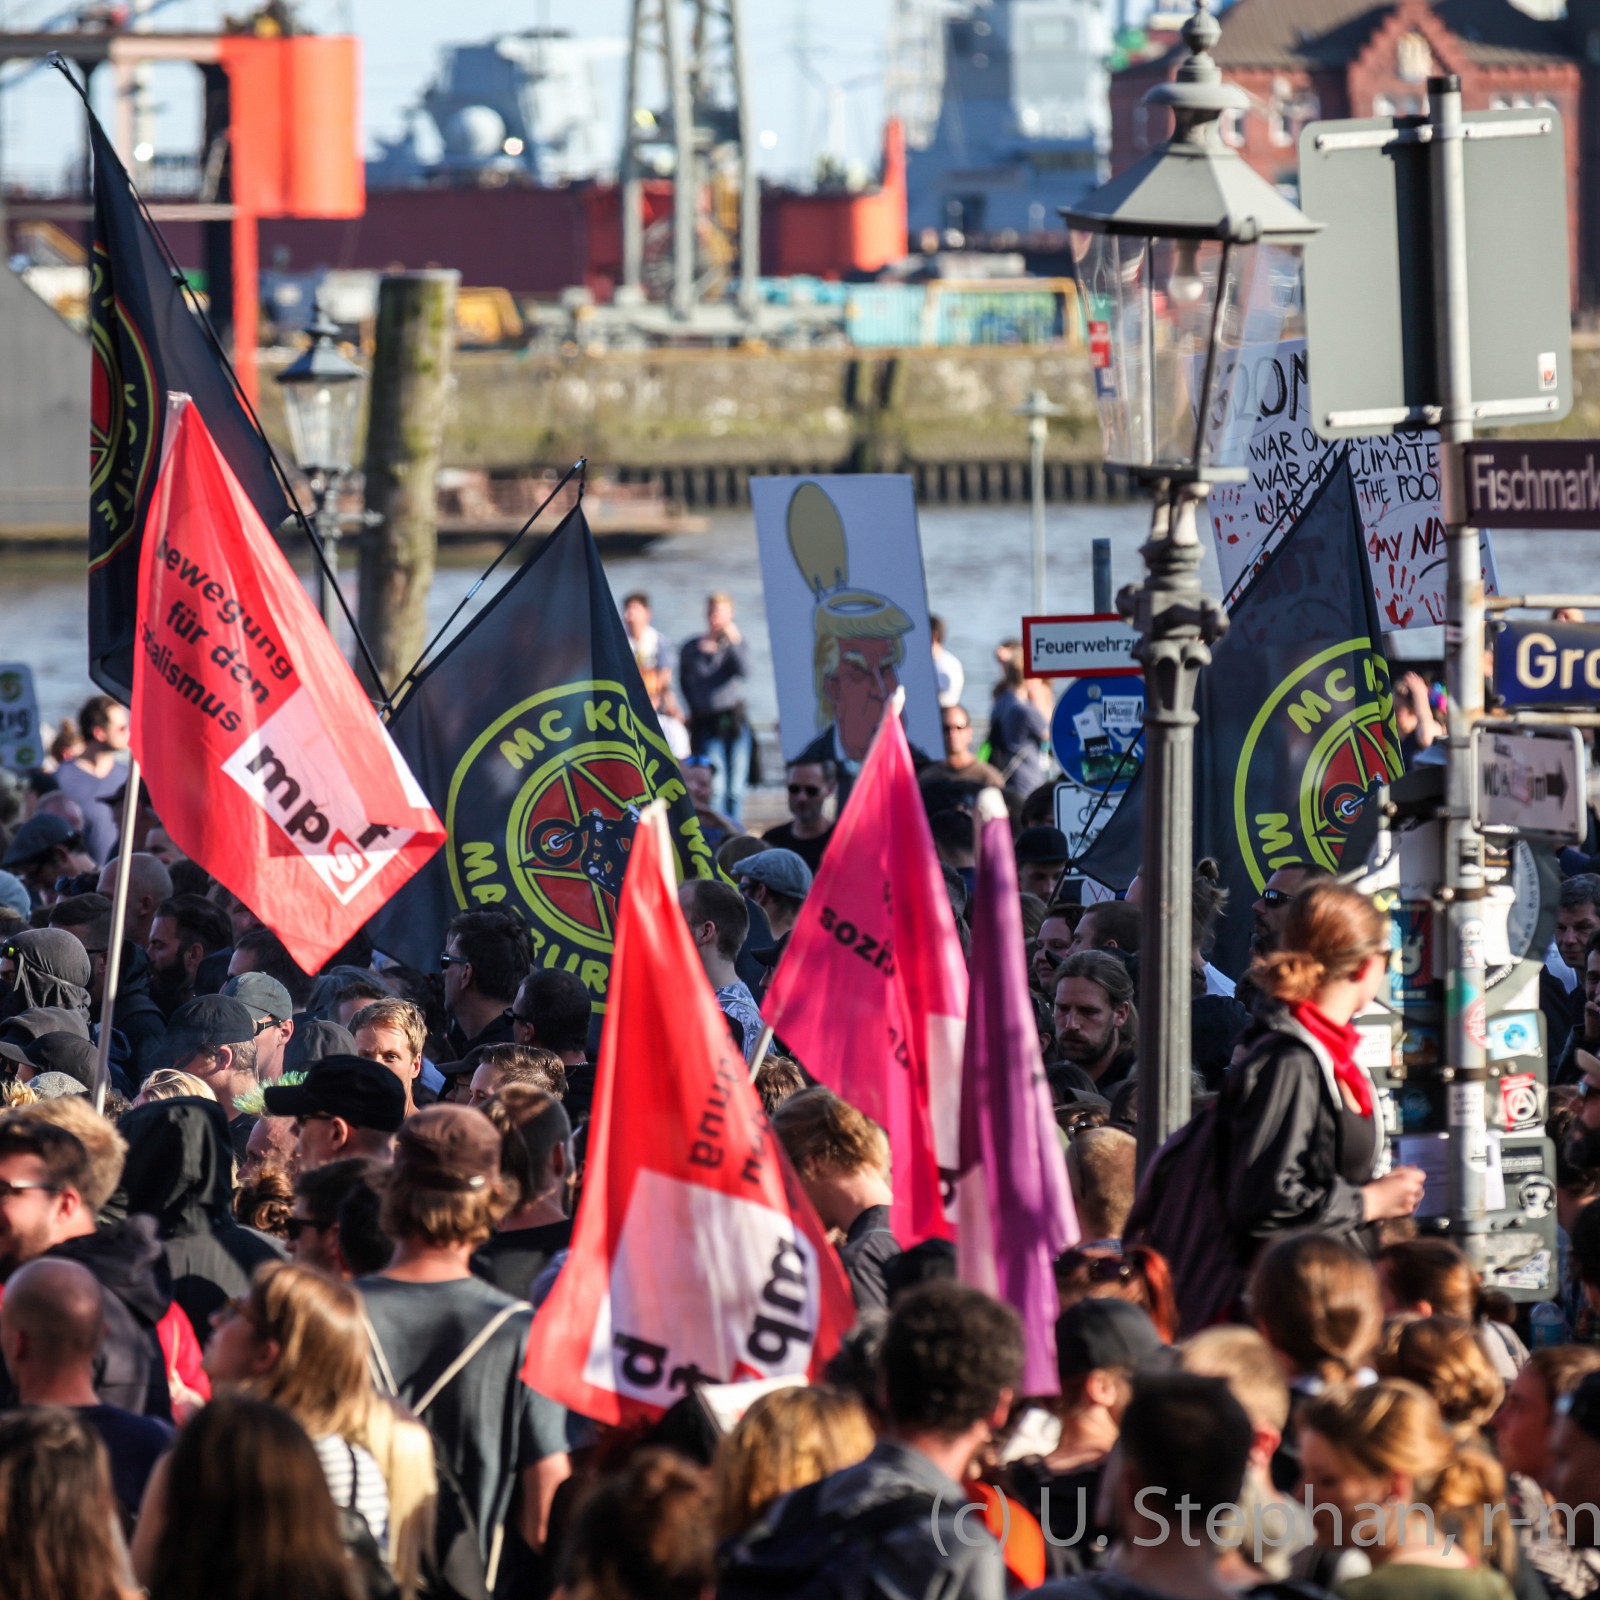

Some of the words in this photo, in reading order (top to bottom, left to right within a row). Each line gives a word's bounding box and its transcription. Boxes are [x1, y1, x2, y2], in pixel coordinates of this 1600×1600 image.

[1250, 431, 1298, 462] WAR
[1349, 442, 1440, 478] CLIMATE
[1252, 461, 1304, 493] WAR
[1356, 479, 1391, 504] THE
[1397, 473, 1440, 503] POO
[1375, 531, 1402, 563] MY
[156, 531, 294, 681] bewegung
[166, 600, 209, 645] für
[210, 644, 270, 704] den
[1287, 668, 1356, 735] MC
[499, 710, 572, 770] MC
